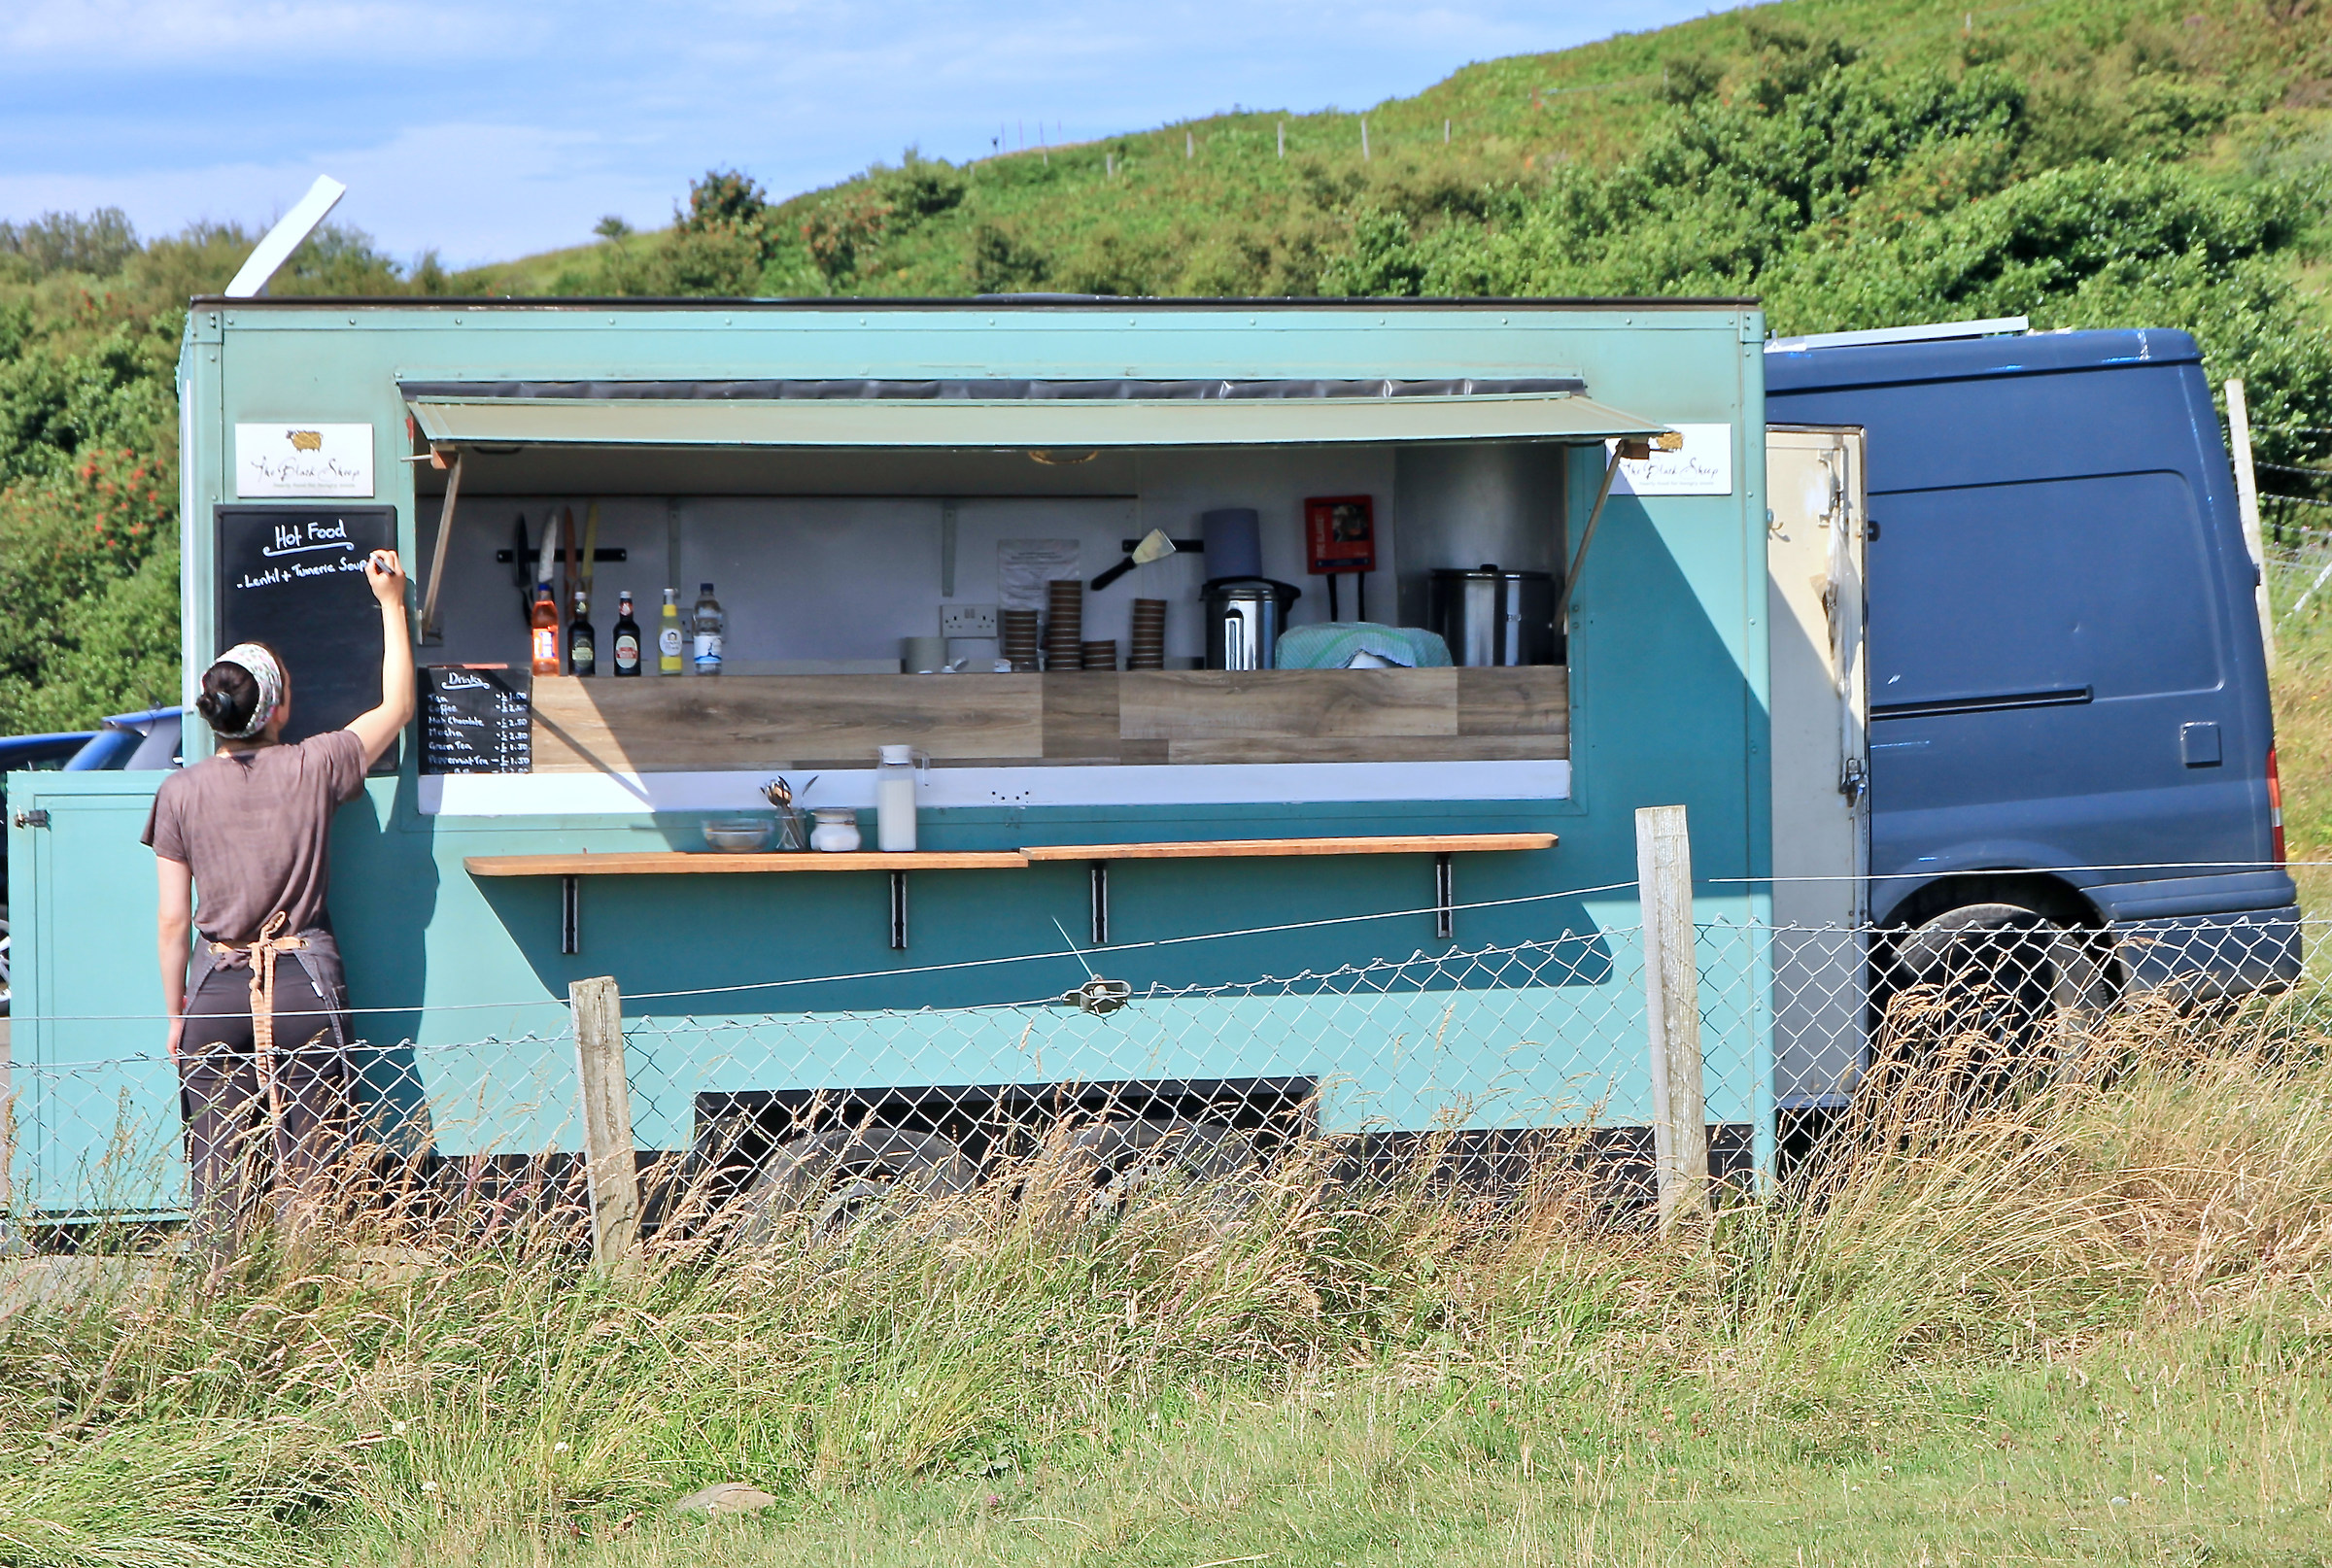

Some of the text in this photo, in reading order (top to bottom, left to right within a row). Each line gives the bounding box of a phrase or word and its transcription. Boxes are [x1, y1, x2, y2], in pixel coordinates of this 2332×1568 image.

[251, 455, 360, 483] The Black Sheep
[1644, 456, 1677, 480] Black
[1679, 457, 1719, 480] Sheep
[274, 518, 347, 550] Hot Food
[338, 556, 368, 573] Soup
[448, 671, 484, 686] Drinks
[428, 694, 449, 703] Tea
[428, 703, 459, 715] Coffee
[428, 716, 446, 725] Hot
[447, 716, 485, 727] Chocolate
[428, 728, 464, 738] Mocha
[428, 741, 454, 751] Green
[454, 740, 473, 751] Tea
[473, 755, 490, 766] Tea
